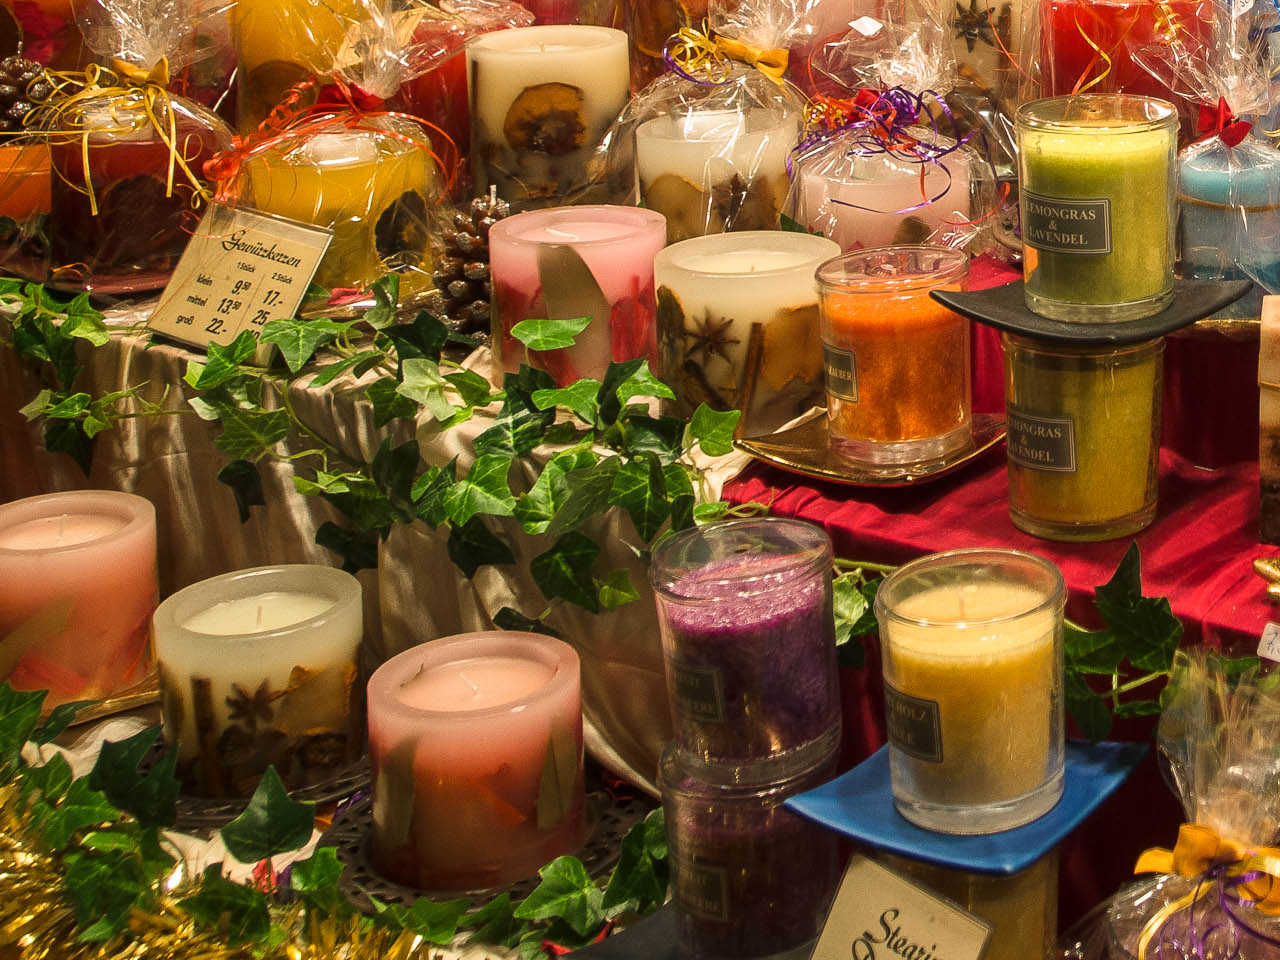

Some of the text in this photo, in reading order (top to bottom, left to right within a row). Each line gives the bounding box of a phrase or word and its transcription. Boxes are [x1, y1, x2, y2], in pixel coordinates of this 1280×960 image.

[1048, 220, 1057, 231] &
[1028, 225, 1089, 246] LAVENDEL
[221, 230, 302, 268] Gewürzkerzen
[186, 295, 208, 307] mittel
[175, 315, 195, 325] groß
[863, 908, 943, 960] Steari
